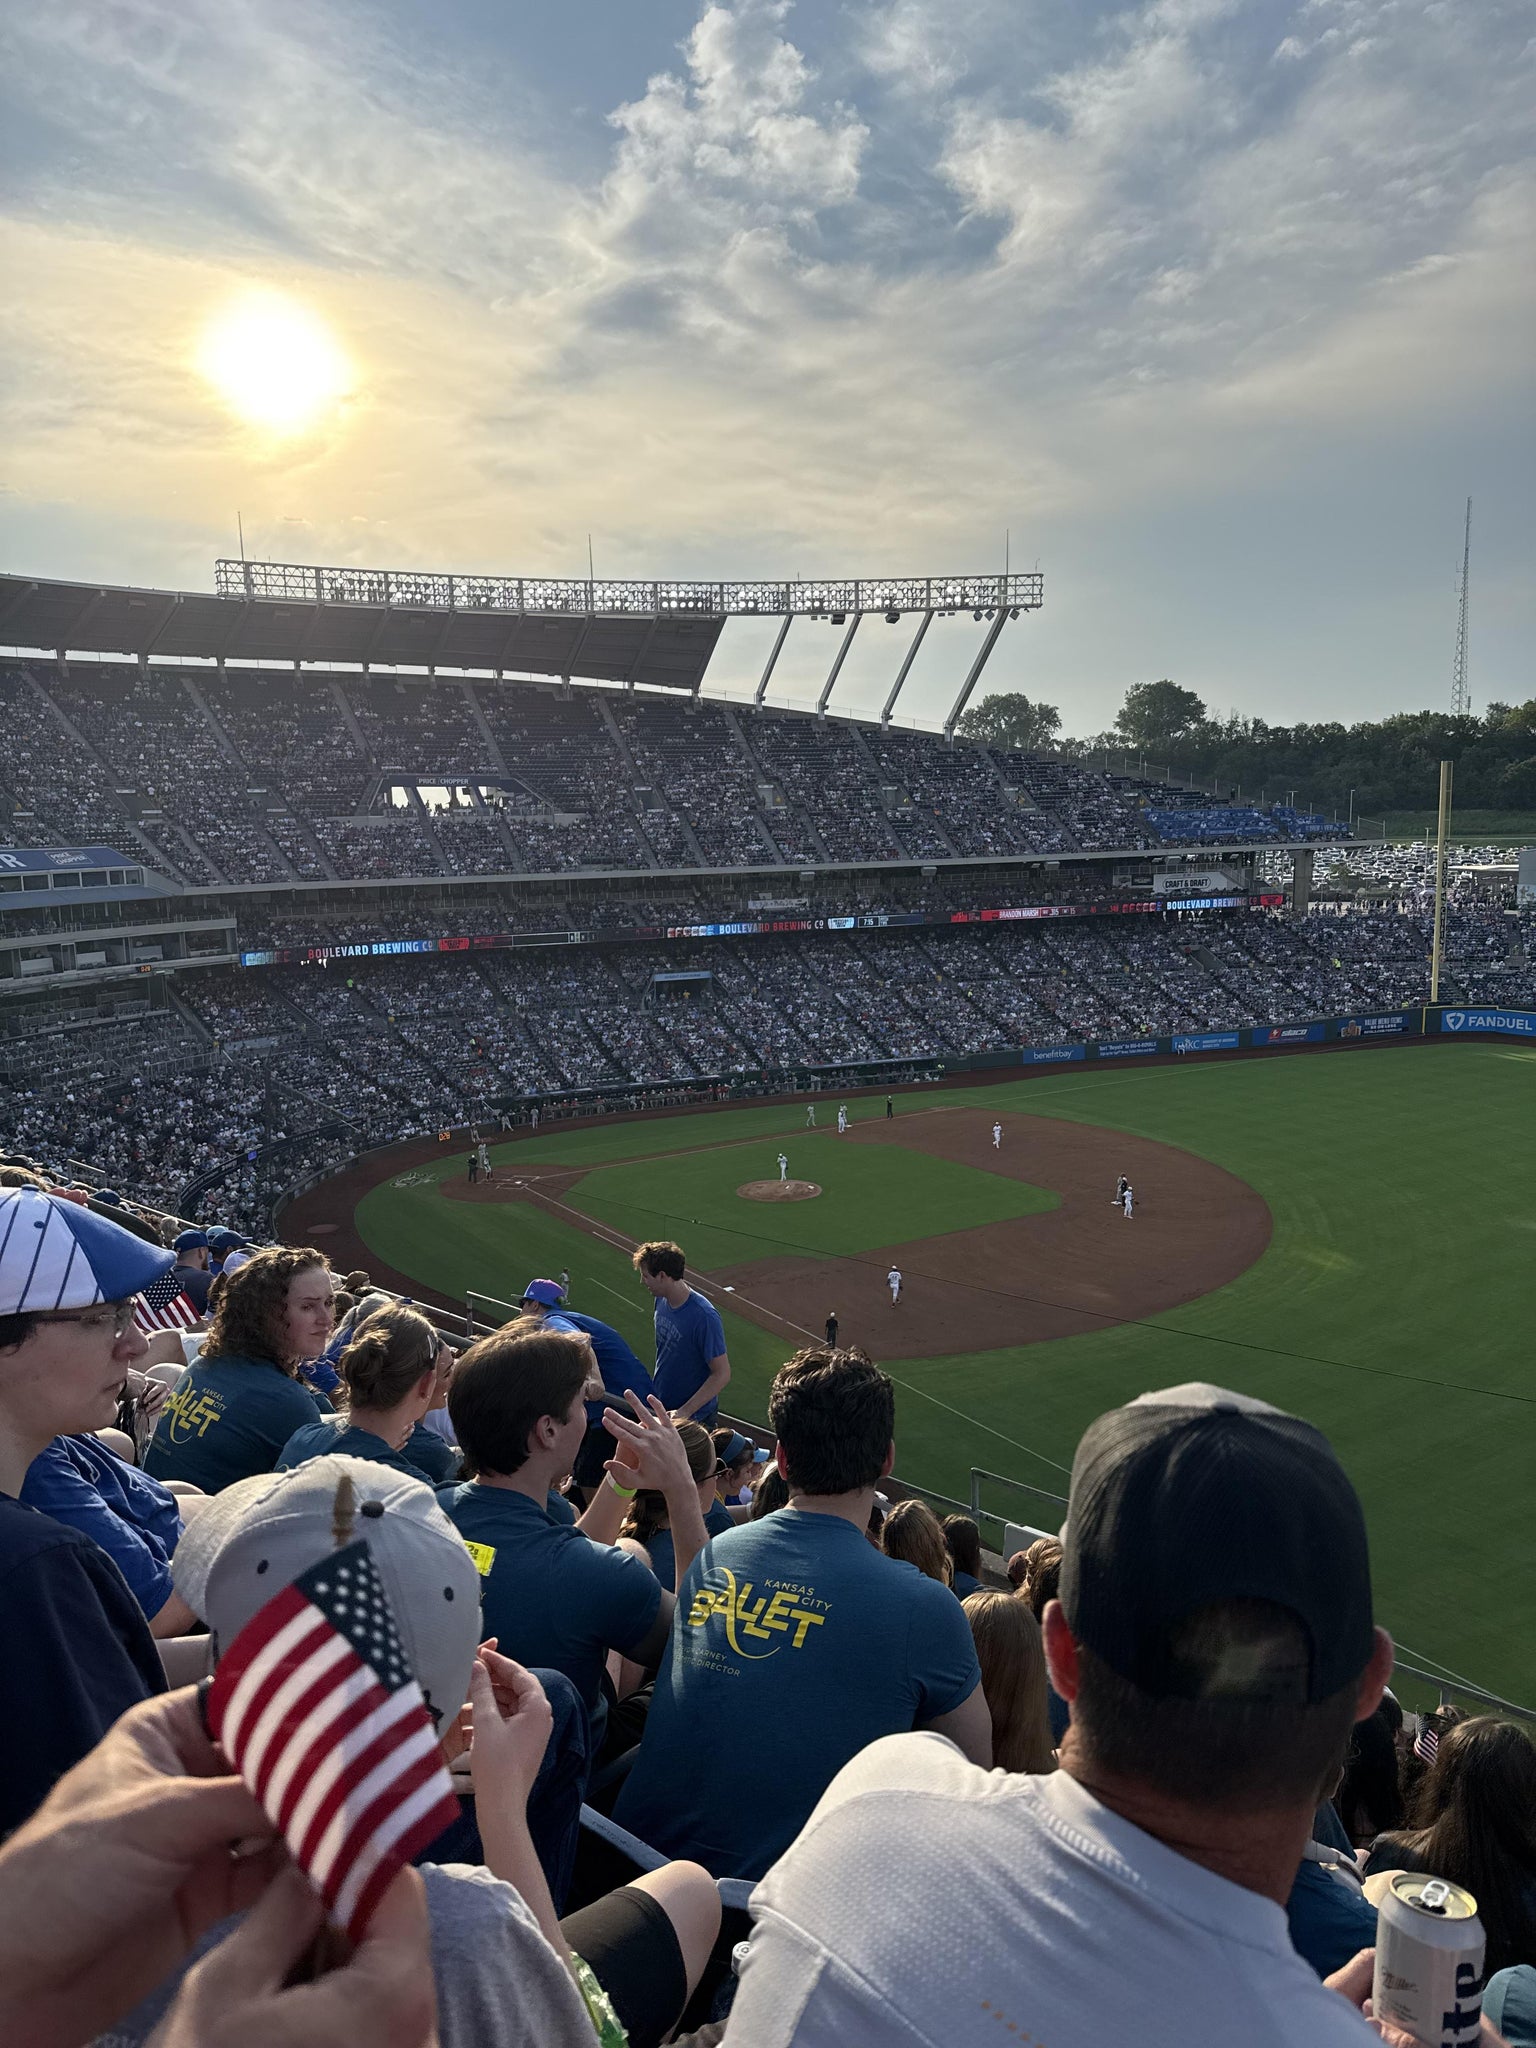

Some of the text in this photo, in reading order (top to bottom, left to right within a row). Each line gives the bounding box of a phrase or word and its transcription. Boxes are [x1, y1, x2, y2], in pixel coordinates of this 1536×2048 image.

[0, 853, 27, 868] R
[1165, 878, 1208, 889] CRAFT & DRAFT
[1167, 899, 1211, 910] BOULEVARD
[1213, 897, 1246, 908] BREWING
[1022, 909, 1039, 918] MARSH
[719, 922, 770, 935] BOULEVARD
[773, 920, 812, 932] BREWING
[308, 944, 369, 959] BOULEVARD
[372, 941, 419, 955] BREWING
[1468, 1015, 1533, 1031] FANDUEL
[1033, 1049, 1072, 1060] benefitbay
[201, 1388, 224, 1401] KANSAS
[213, 1402, 228, 1411] CITY
[764, 1579, 815, 1596] KANSAS
[801, 1597, 833, 1611] CITY
[687, 1567, 826, 1660] BALLET
[697, 1659, 741, 1677] DIRECTOR
